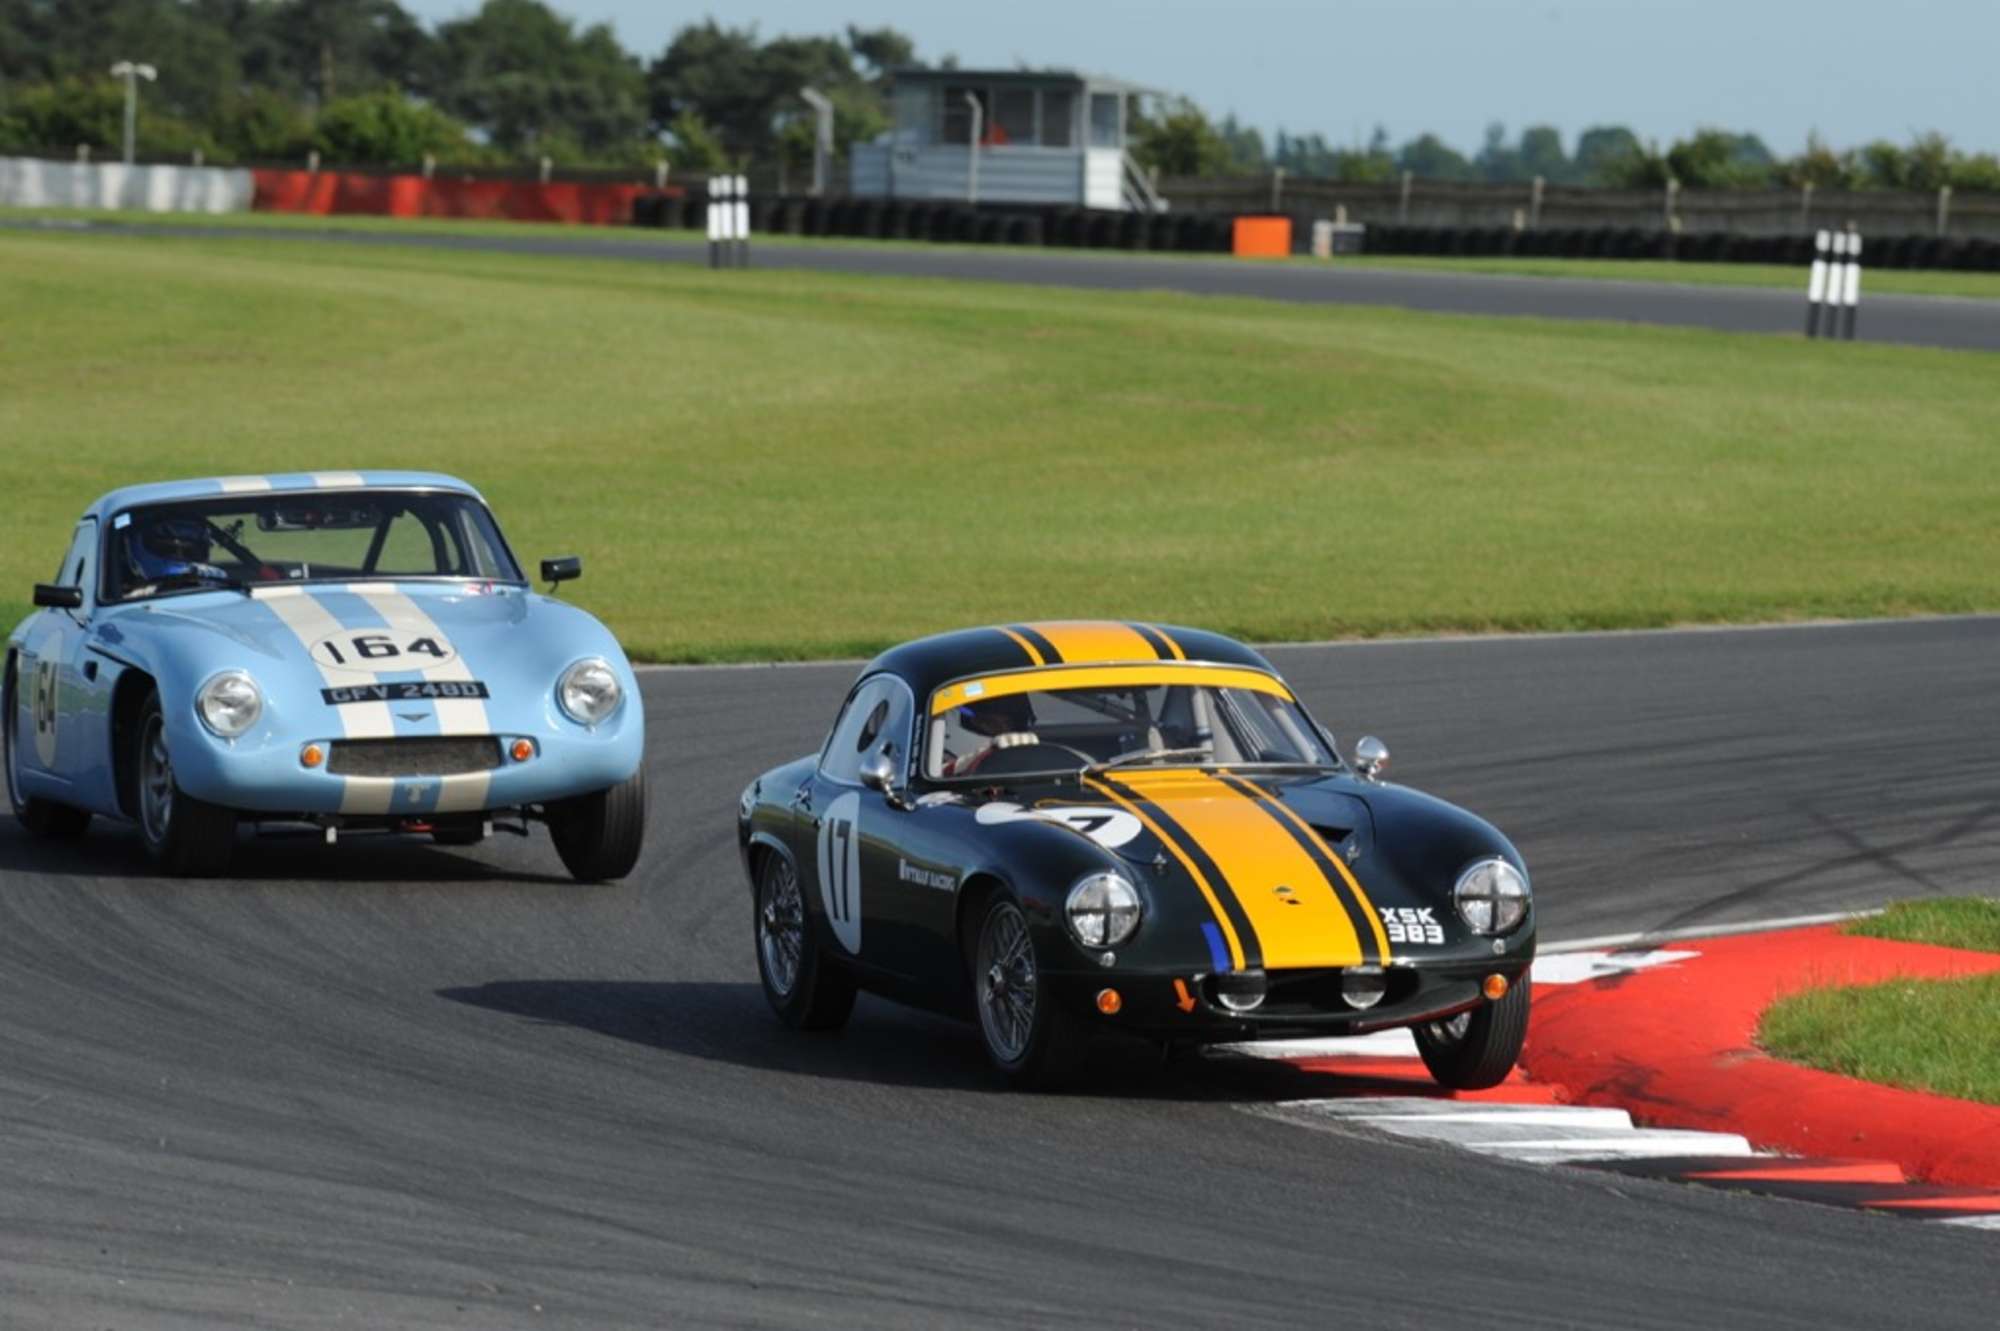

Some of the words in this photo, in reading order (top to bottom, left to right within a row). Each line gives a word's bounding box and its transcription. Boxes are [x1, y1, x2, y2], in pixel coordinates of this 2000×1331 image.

[323, 635, 448, 664] 164
[331, 688, 390, 702] GFV
[401, 682, 480, 698] 248D
[827, 818, 852, 922] 17
[1379, 907, 1438, 925] XSK
[1387, 924, 1445, 944] 383
